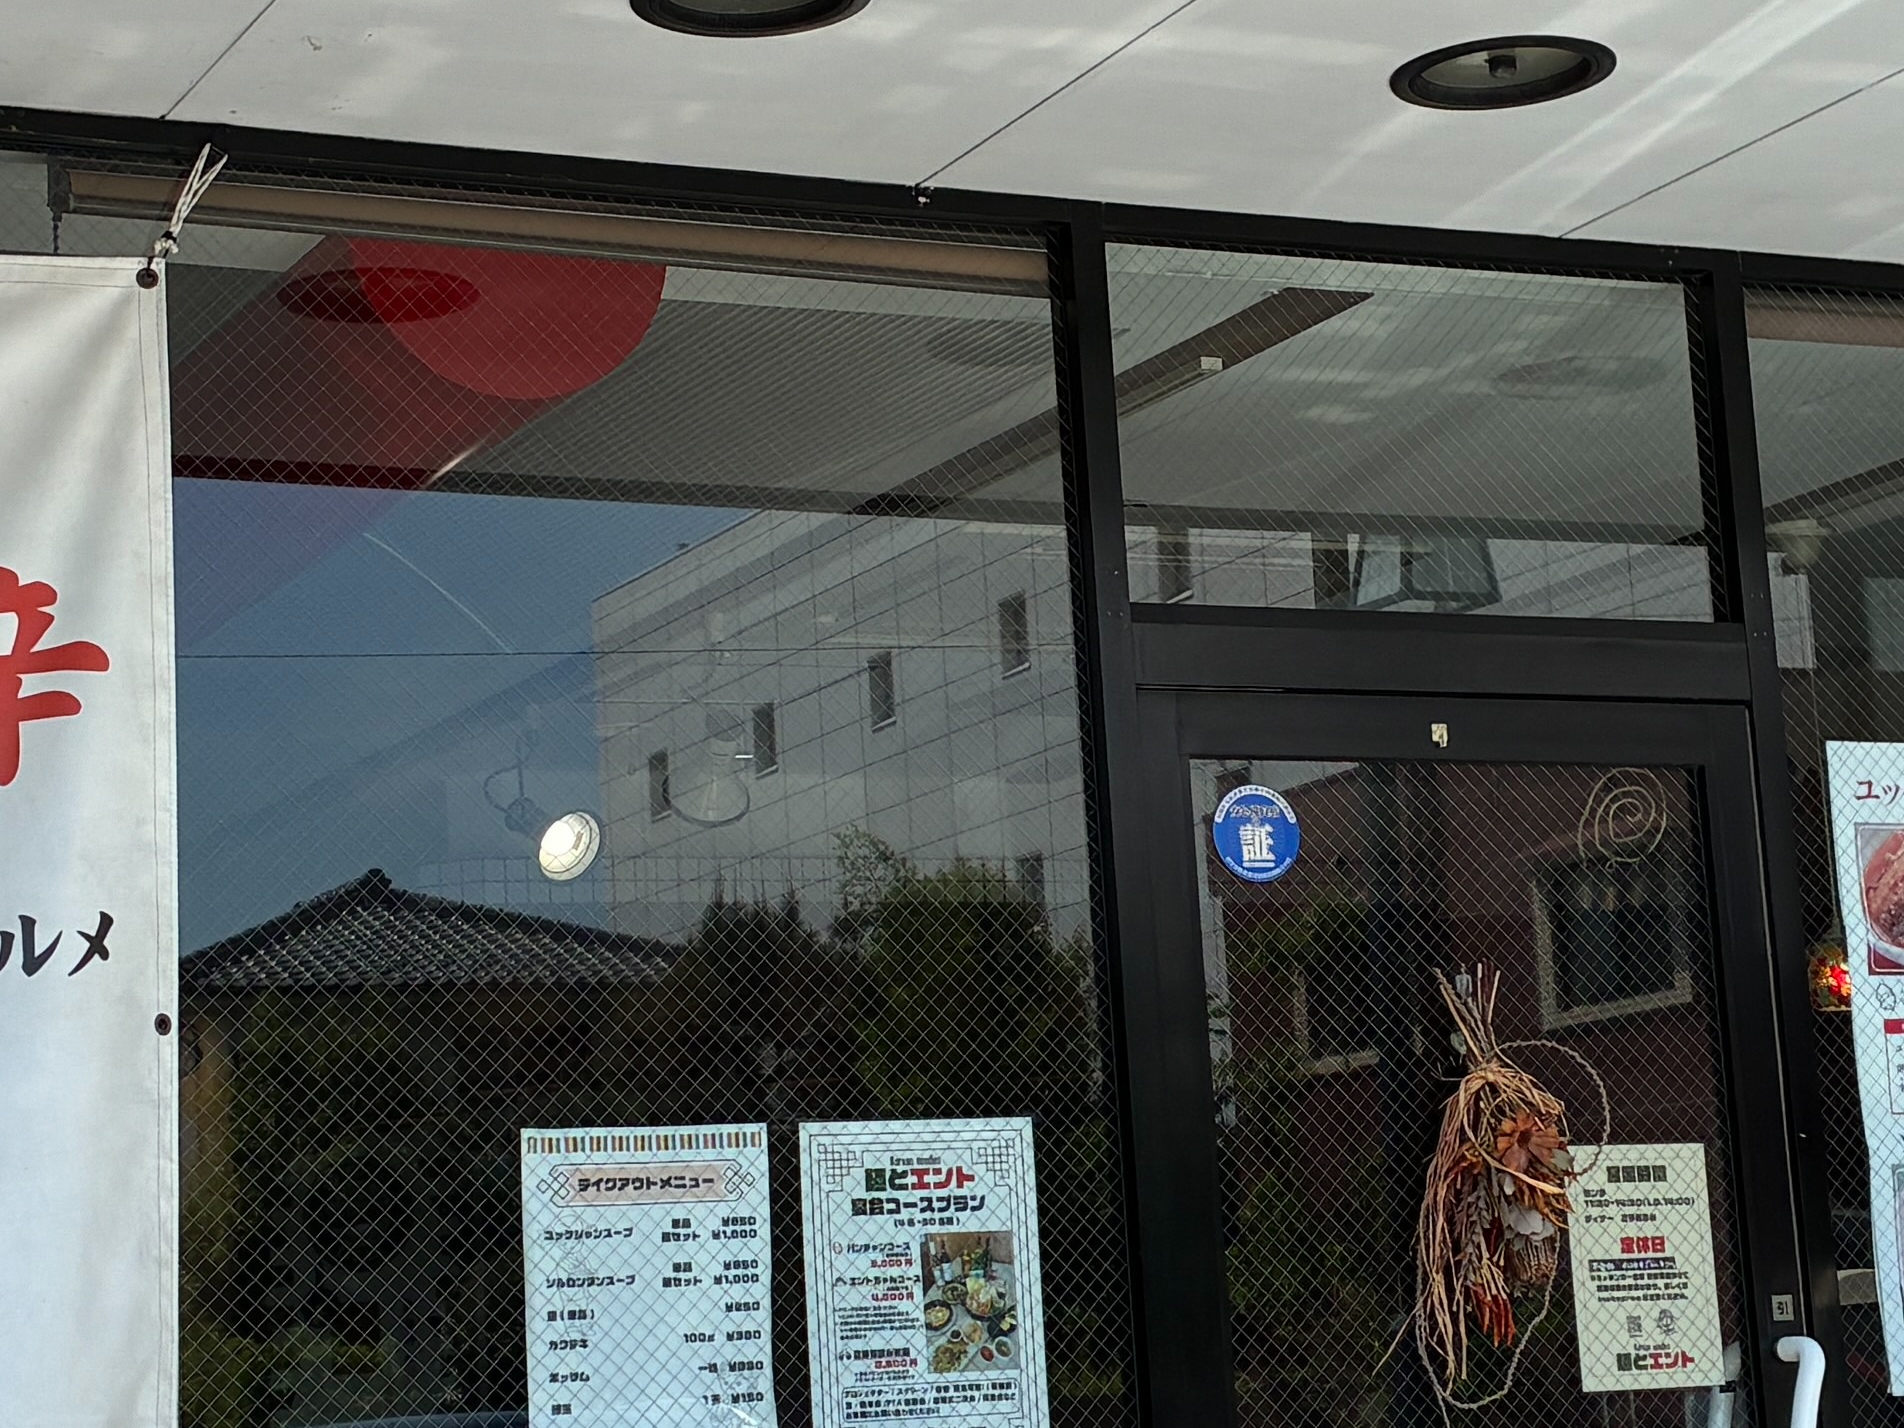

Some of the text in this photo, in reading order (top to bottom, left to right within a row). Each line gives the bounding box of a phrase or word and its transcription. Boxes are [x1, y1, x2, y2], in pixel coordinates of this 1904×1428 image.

[577, 1176, 715, 1193] テイクアウトメニュー
